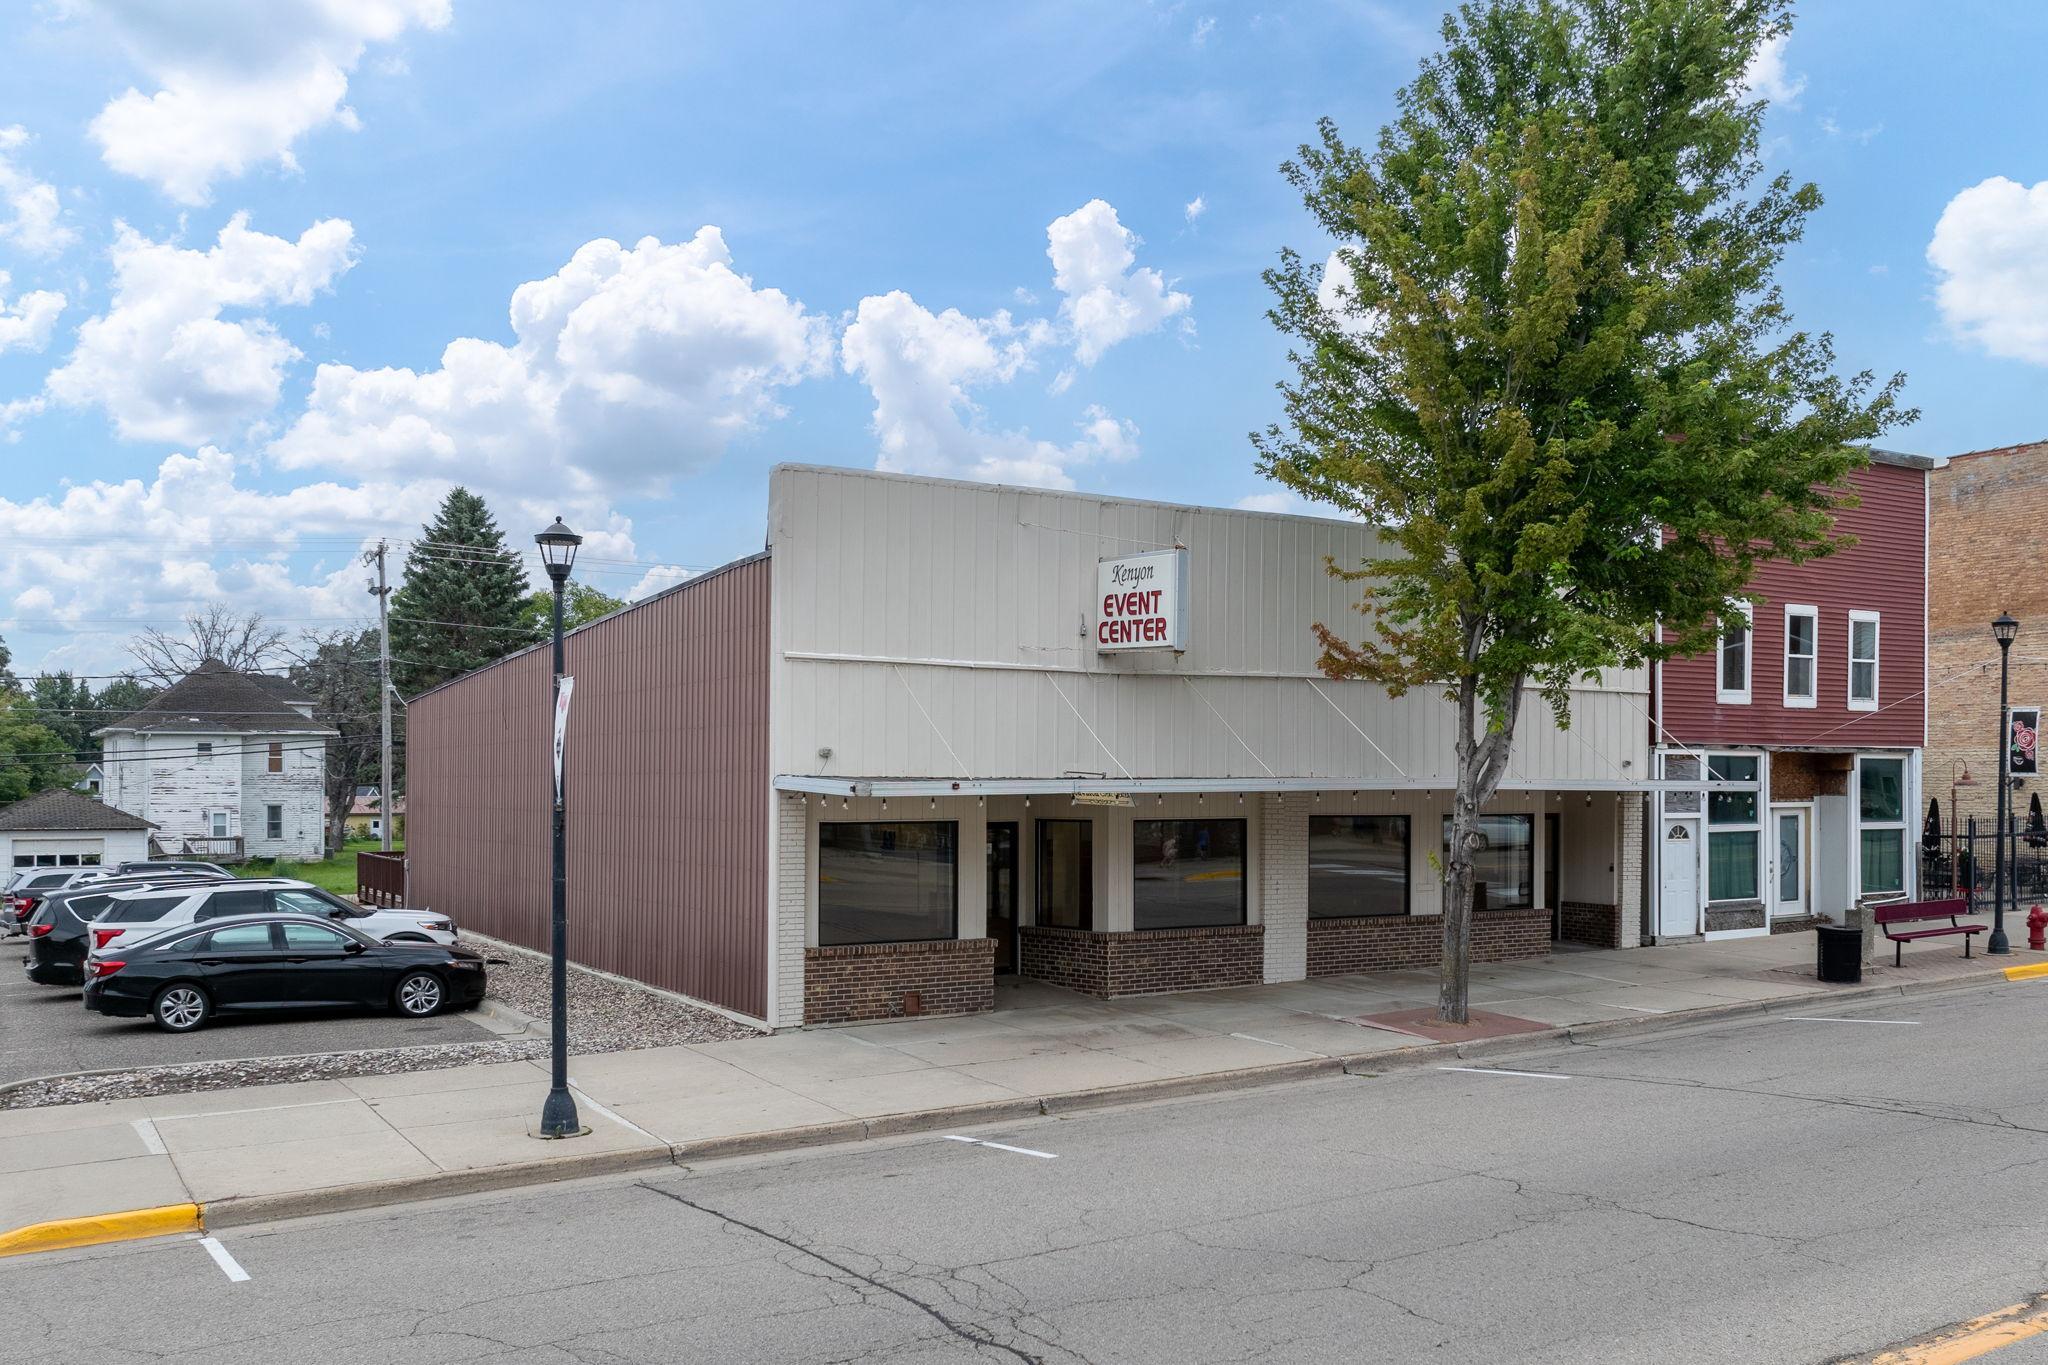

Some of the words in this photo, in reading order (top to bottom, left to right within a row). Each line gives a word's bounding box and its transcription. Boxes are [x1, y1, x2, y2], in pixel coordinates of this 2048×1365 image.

[1112, 564, 1154, 589] Kenyon
[1104, 590, 1162, 617] EVENT
[1099, 618, 1167, 644] CENTER
